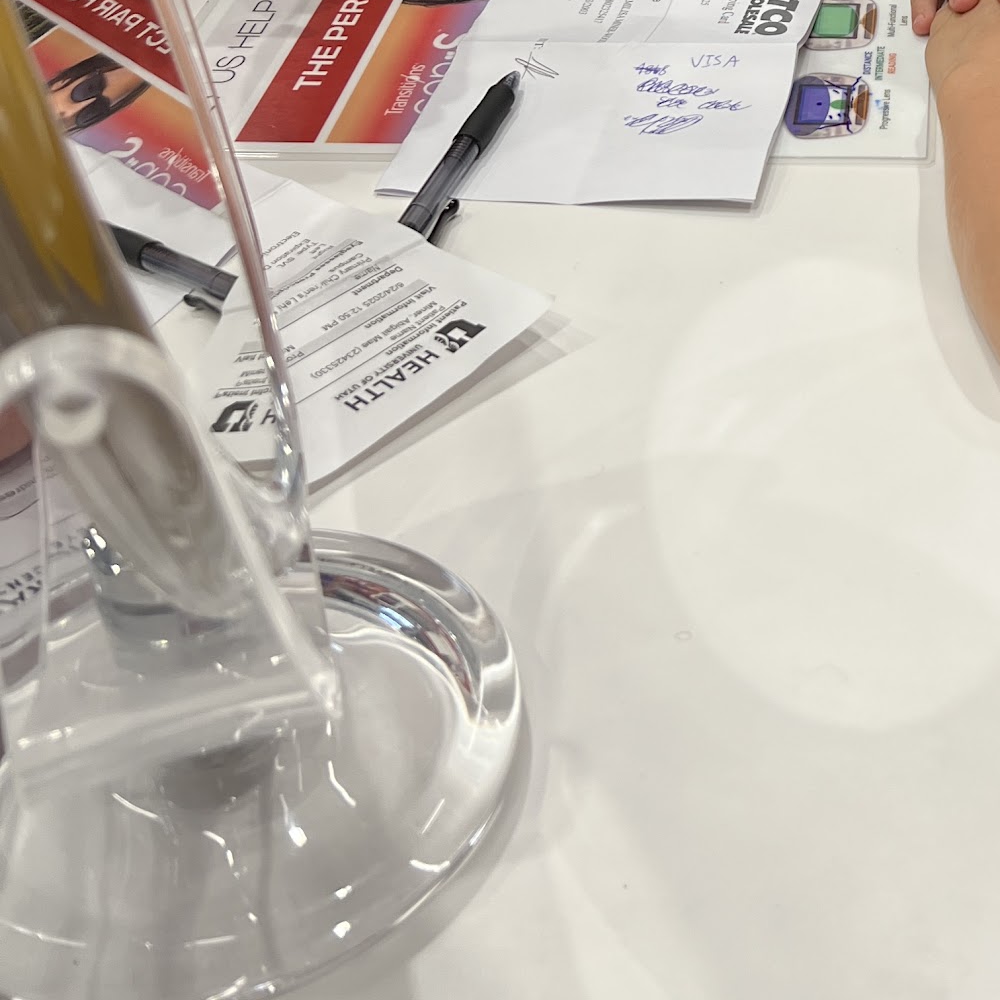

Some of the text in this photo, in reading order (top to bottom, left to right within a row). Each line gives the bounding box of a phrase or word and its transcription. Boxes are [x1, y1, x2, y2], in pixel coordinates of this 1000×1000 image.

[228, 0, 277, 50] HELP
[718, 11, 735, 24] Card
[887, 4, 898, 37] Multi-Functional
[212, 54, 246, 84] US
[292, 45, 340, 92] THE
[691, 54, 740, 68] VISA
[862, 51, 873, 75] DISTANCE
[874, 46, 886, 81] INTERMEDIATE
[888, 53, 897, 74] READING
[384, 60, 426, 116] Transitions
[879, 89, 892, 129] Progressive Lens
[328, 252, 364, 273] Campus
[340, 256, 373, 275] Primary
[351, 265, 403, 296] Department
[364, 285, 437, 329] Visit Information
[390, 305, 446, 341] Patient Name
[321, 320, 340, 331] PM
[361, 334, 383, 349] Mae
[383, 320, 410, 337] Abigail
[385, 300, 467, 356] Patient Information
[334, 343, 423, 401] UNIVERSITY OF UTAH
[344, 350, 440, 411] HEALTH
